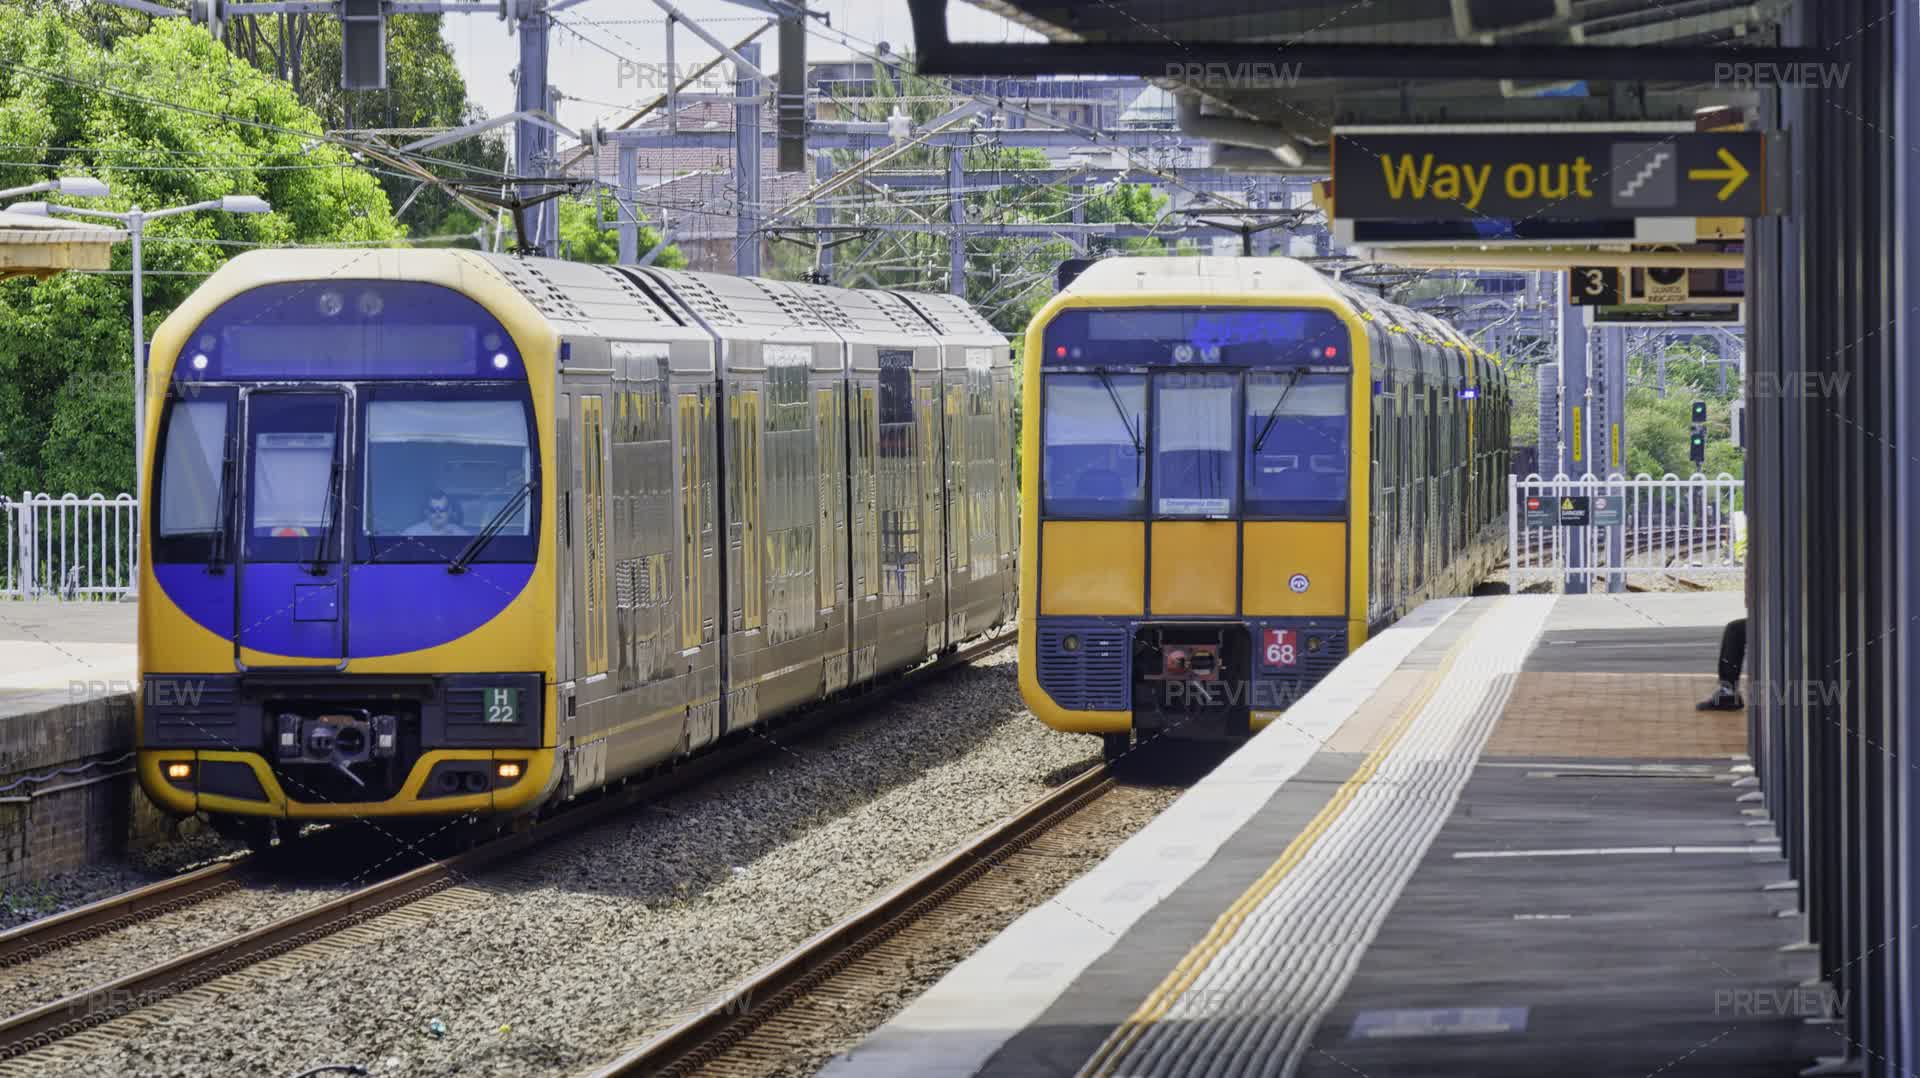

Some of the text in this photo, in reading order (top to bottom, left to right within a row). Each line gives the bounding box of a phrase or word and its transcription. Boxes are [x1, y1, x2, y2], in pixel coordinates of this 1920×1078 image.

[1379, 153, 1594, 210] Way out
[1584, 269, 1604, 296] 3
[1271, 629, 1288, 645] T
[1266, 643, 1295, 664] 68
[494, 688, 508, 706] H
[488, 705, 513, 723] 22
